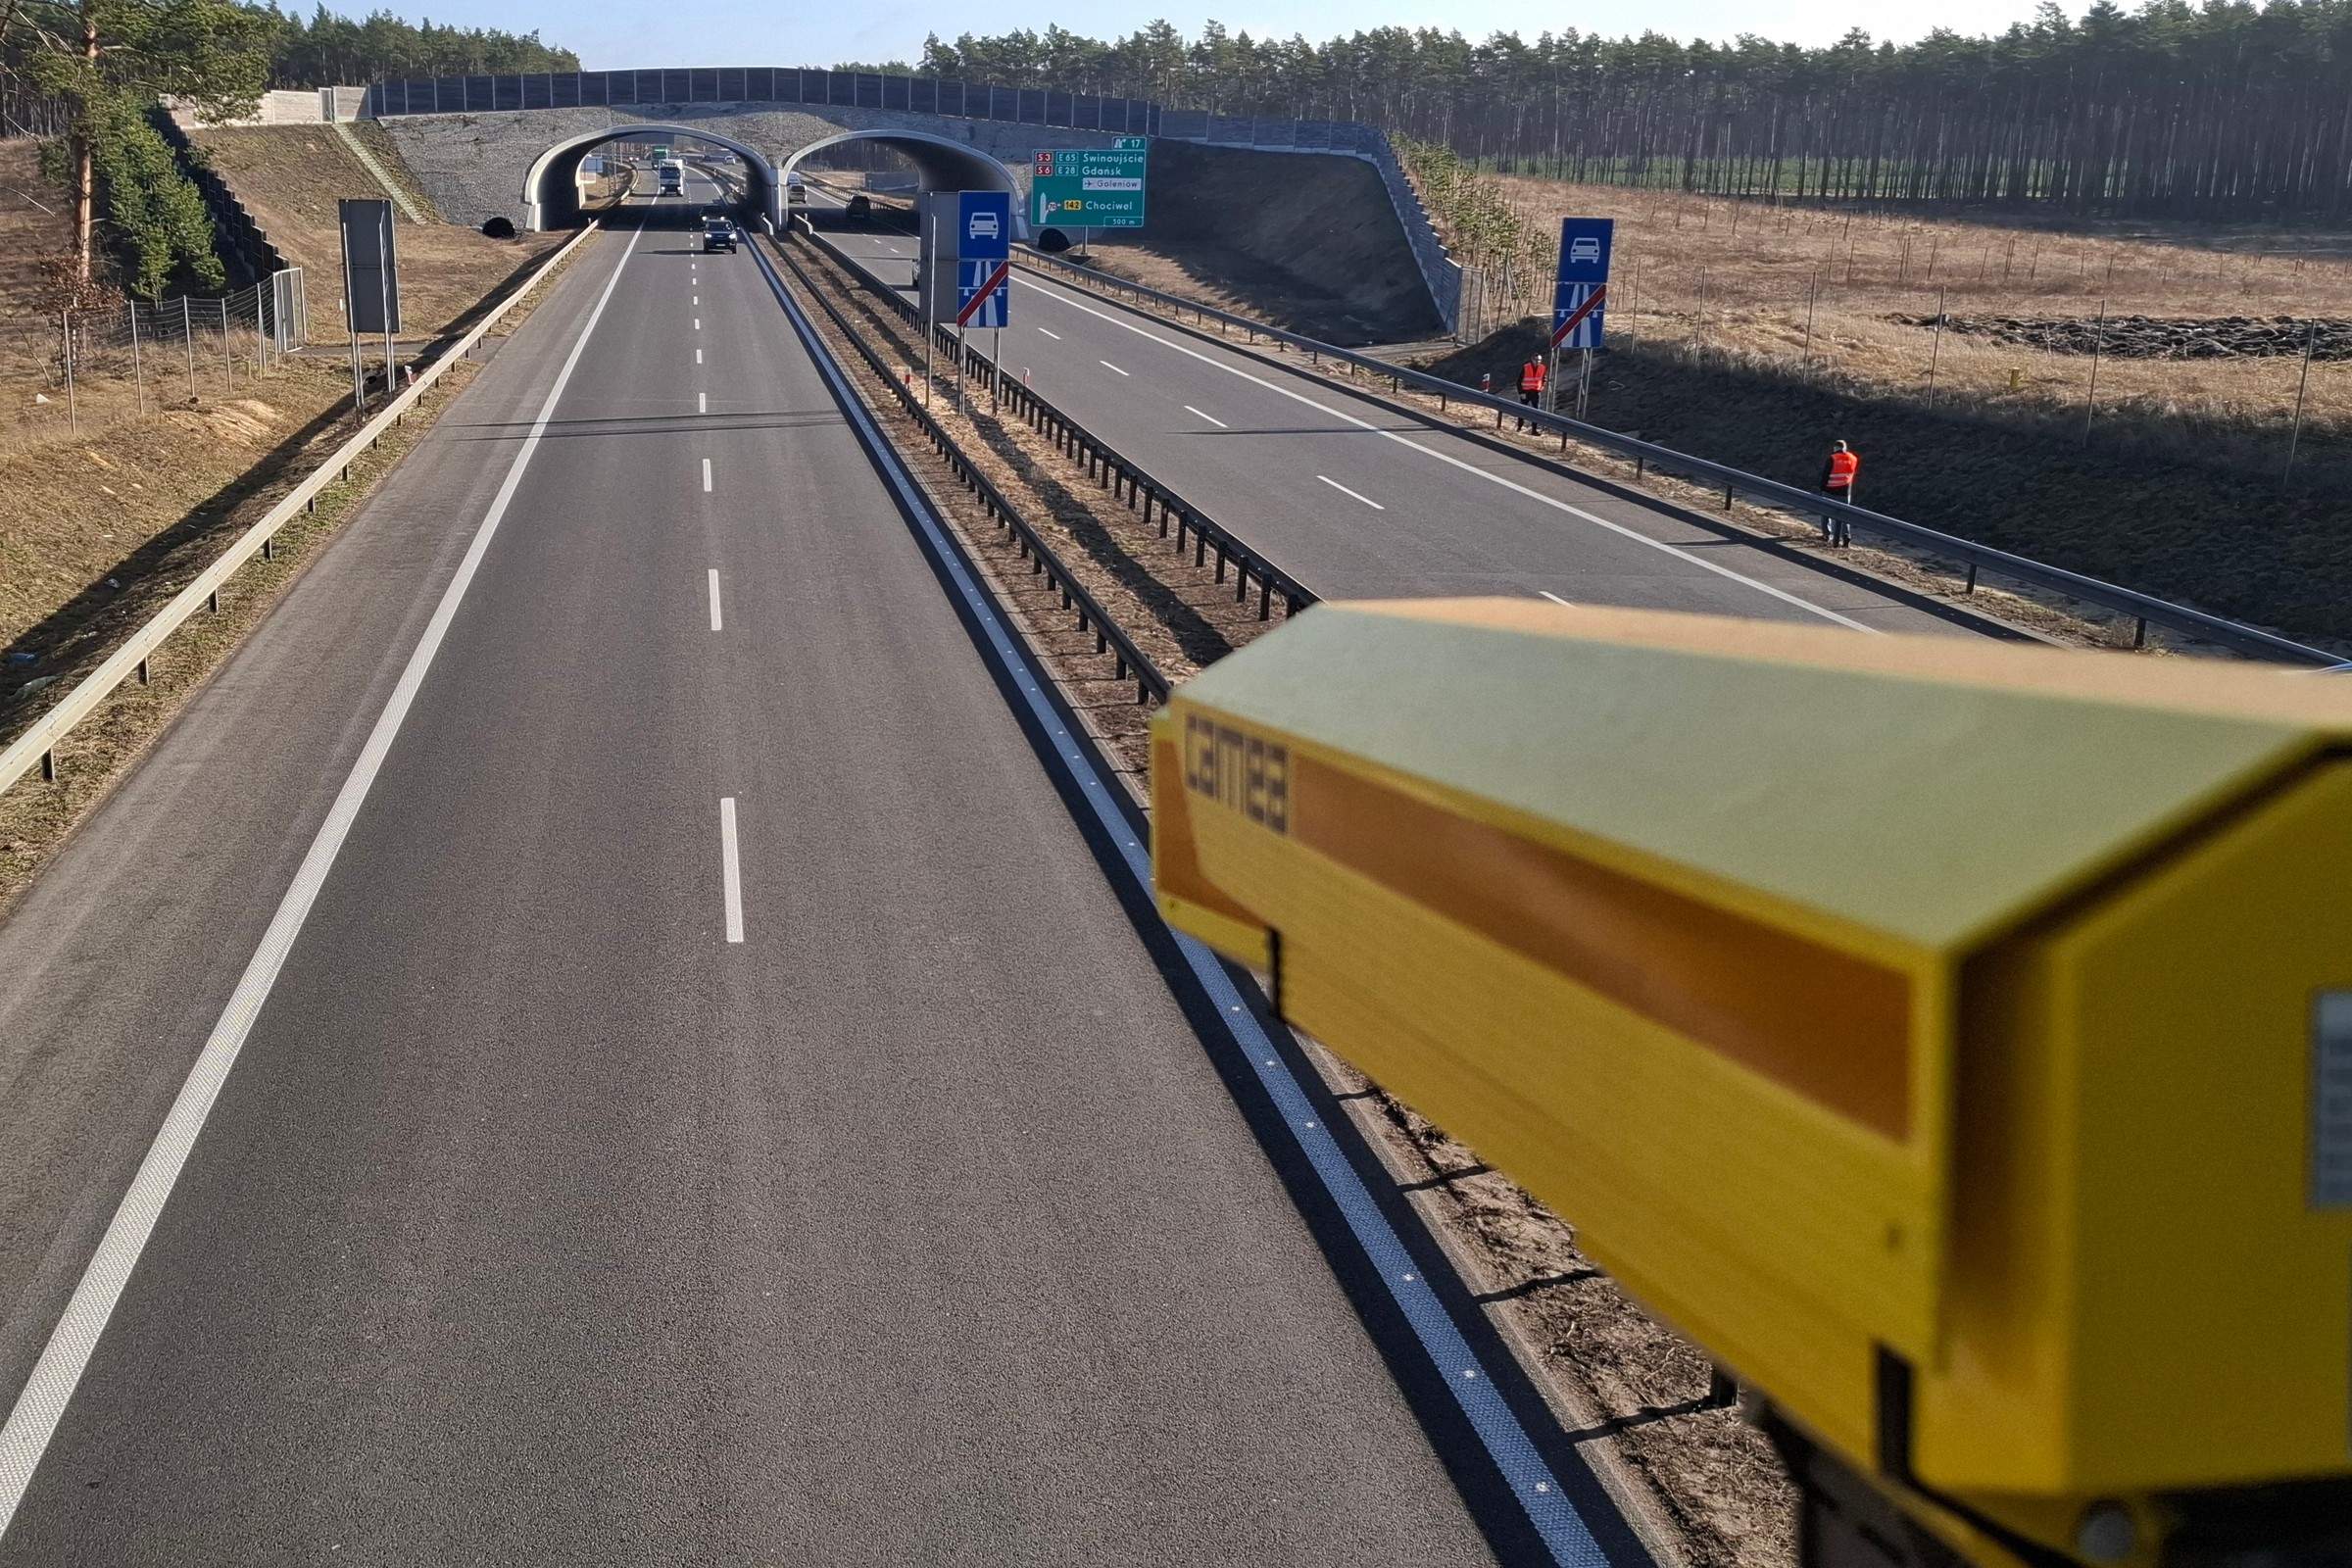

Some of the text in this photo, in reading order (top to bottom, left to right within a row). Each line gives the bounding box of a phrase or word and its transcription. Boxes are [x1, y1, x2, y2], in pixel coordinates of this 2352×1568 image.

[1131, 139, 1141, 148] 17
[1082, 166, 1121, 175] Gdańsk
[1085, 201, 1133, 211] Chociwel
